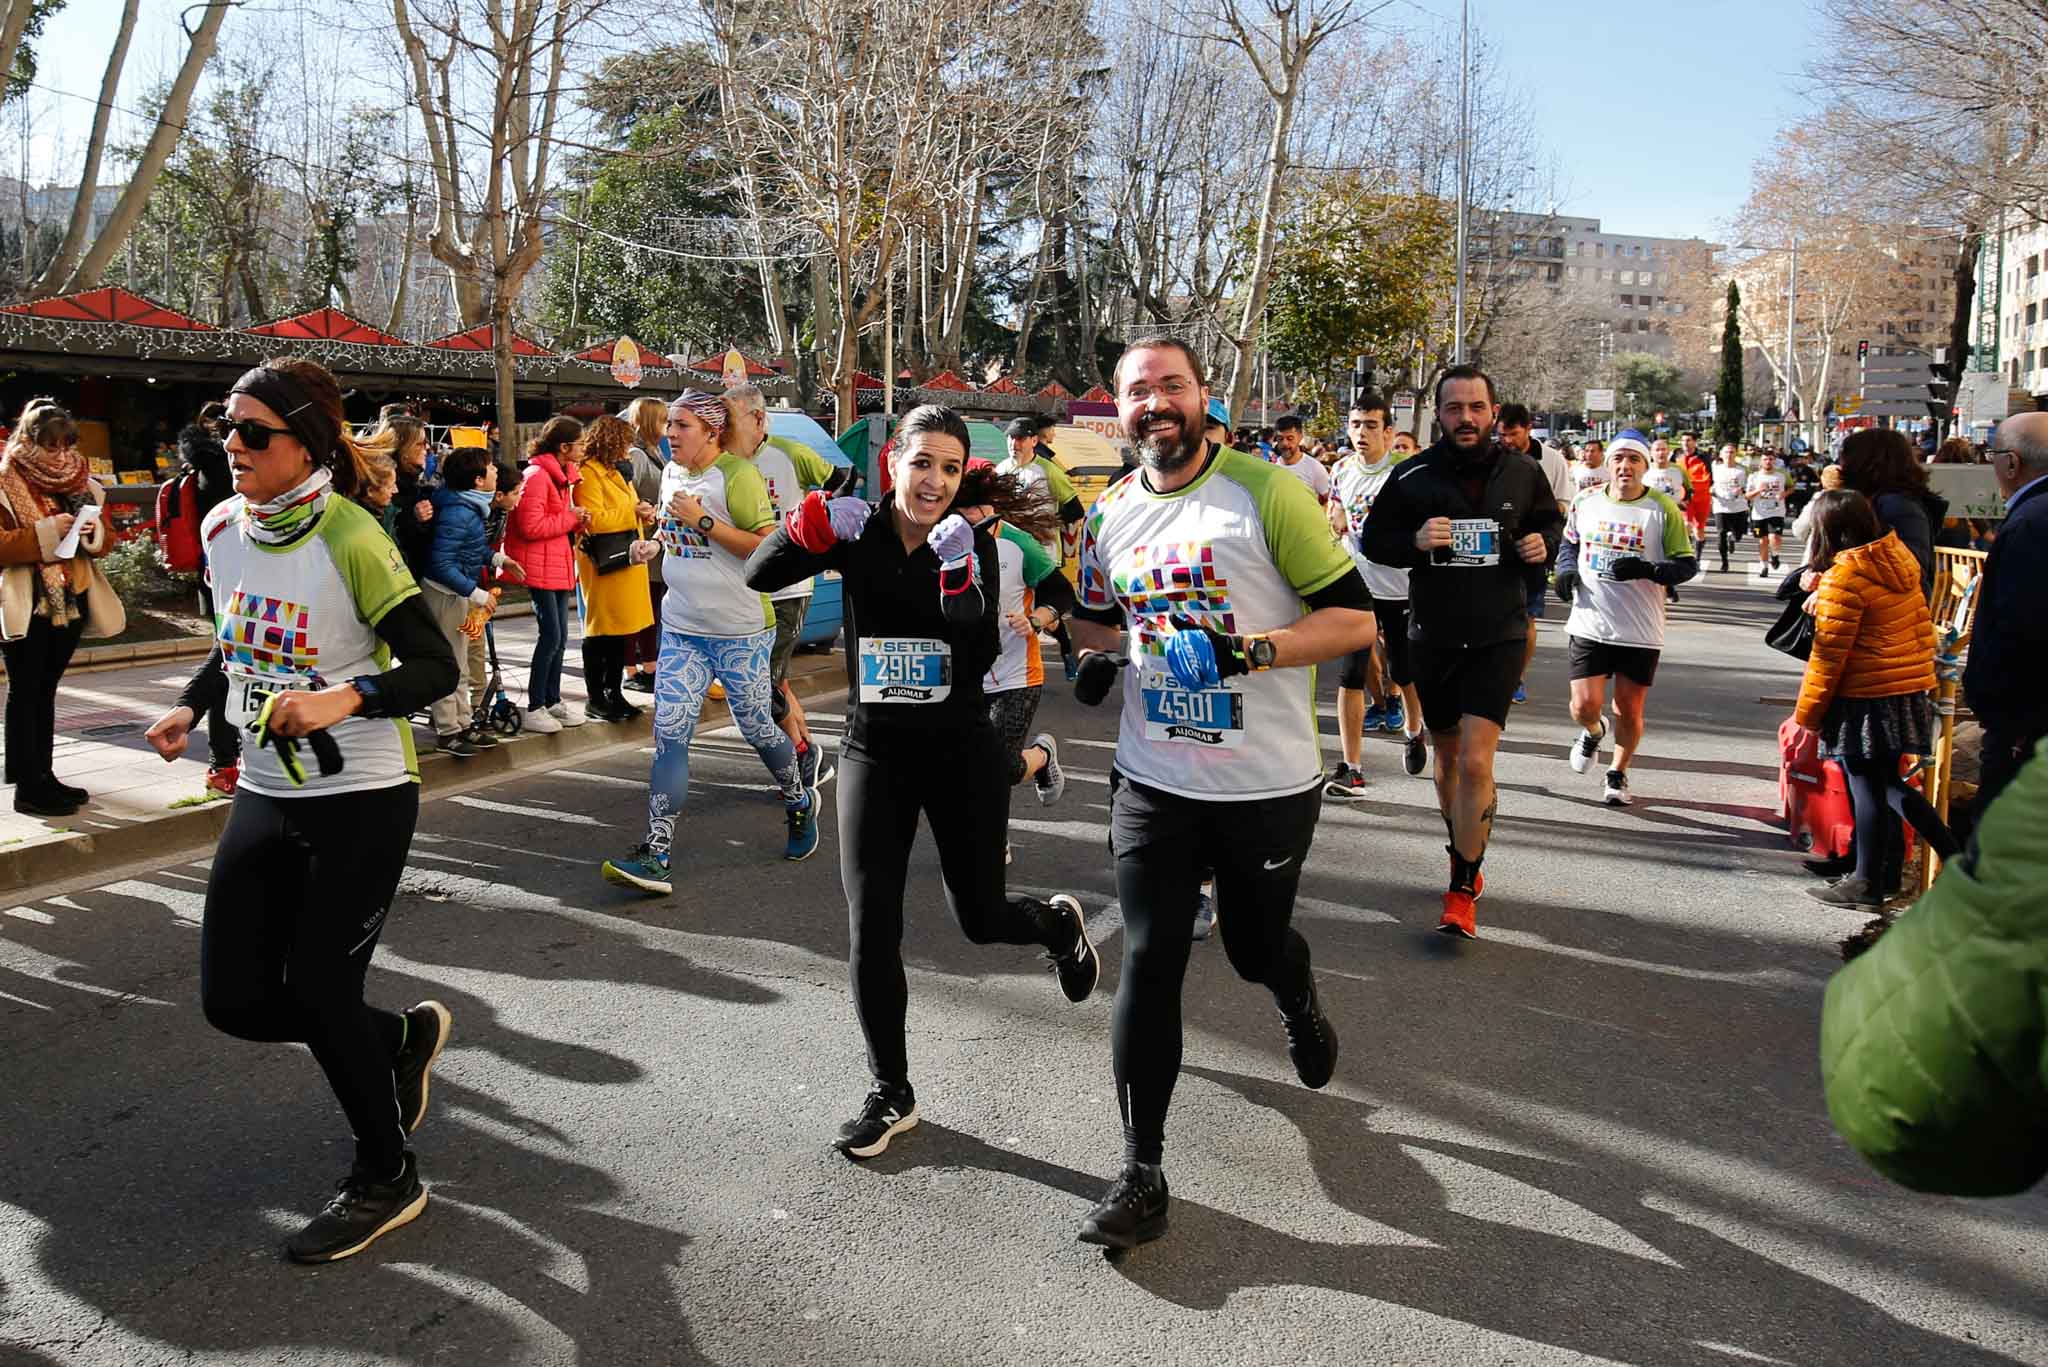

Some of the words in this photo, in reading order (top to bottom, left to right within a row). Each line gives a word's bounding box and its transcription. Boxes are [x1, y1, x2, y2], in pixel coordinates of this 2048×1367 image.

[1449, 533, 1480, 551] 831
[884, 641, 942, 653] SETEL
[875, 655, 925, 681] 2915
[887, 687, 924, 699] ALJOMAR
[1158, 691, 1214, 723] 4501
[1175, 727, 1214, 743] ALJOMAR
